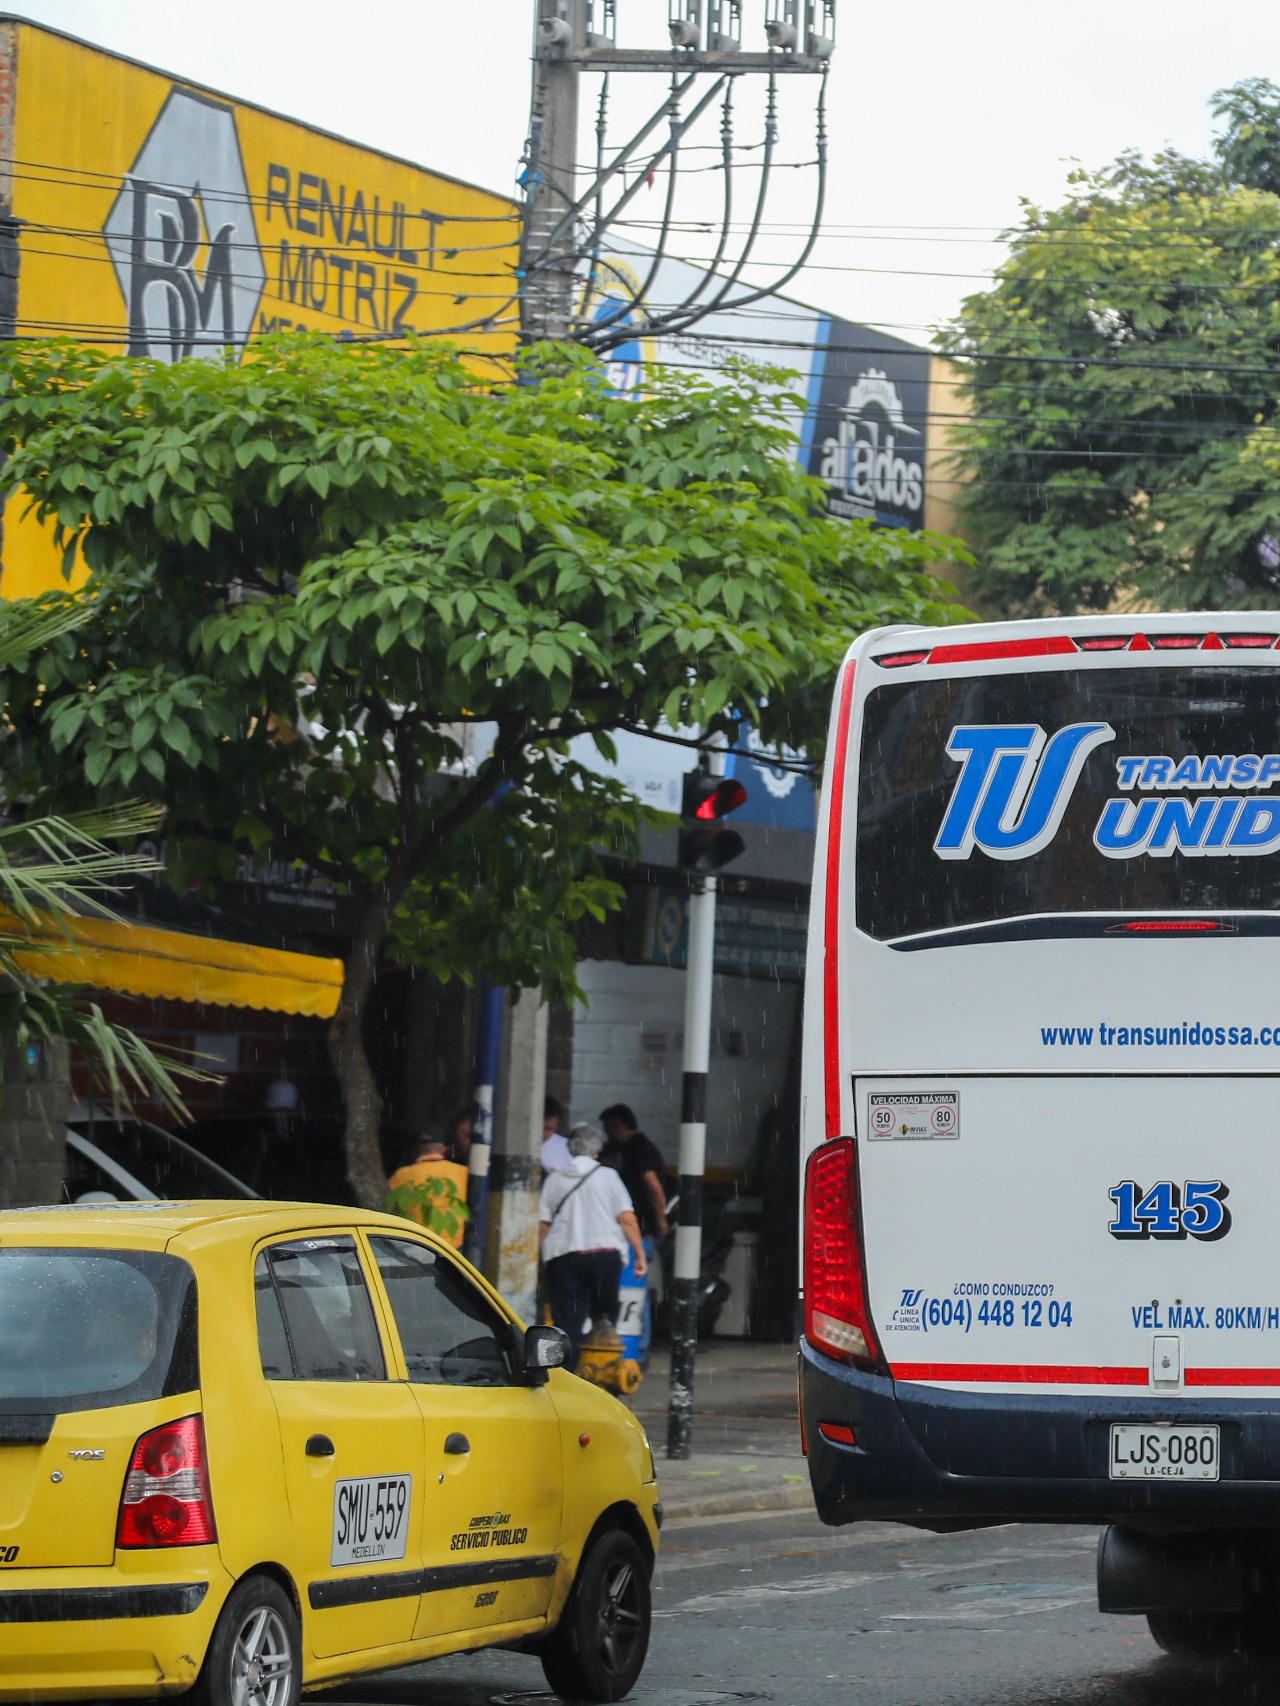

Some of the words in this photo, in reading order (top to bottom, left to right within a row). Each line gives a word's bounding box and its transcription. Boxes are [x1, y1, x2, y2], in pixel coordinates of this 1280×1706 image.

[266, 163, 445, 270] RENAULT
[279, 239, 419, 337] MOTRIZ
[873, 1096, 920, 1105] VELOCIDAD
[921, 1093, 955, 1104] MÁXIMA
[877, 1112, 891, 1123] 50
[936, 1111, 951, 1122] 80
[1108, 1180, 1233, 1242] 145
[953, 1283, 990, 1296] ¿COMO
[992, 1284, 1055, 1297] CONDUZCO?
[921, 1298, 973, 1333] (604)
[978, 1299, 1015, 1327] 448
[1021, 1301, 1043, 1327] 12
[1048, 1300, 1073, 1328] 04
[1168, 1306, 1210, 1329] MAX.
[450, 1529, 489, 1551] SERVICIO
[490, 1526, 528, 1547] PUBLICO
[351, 1543, 386, 1559] MEDELLIN
